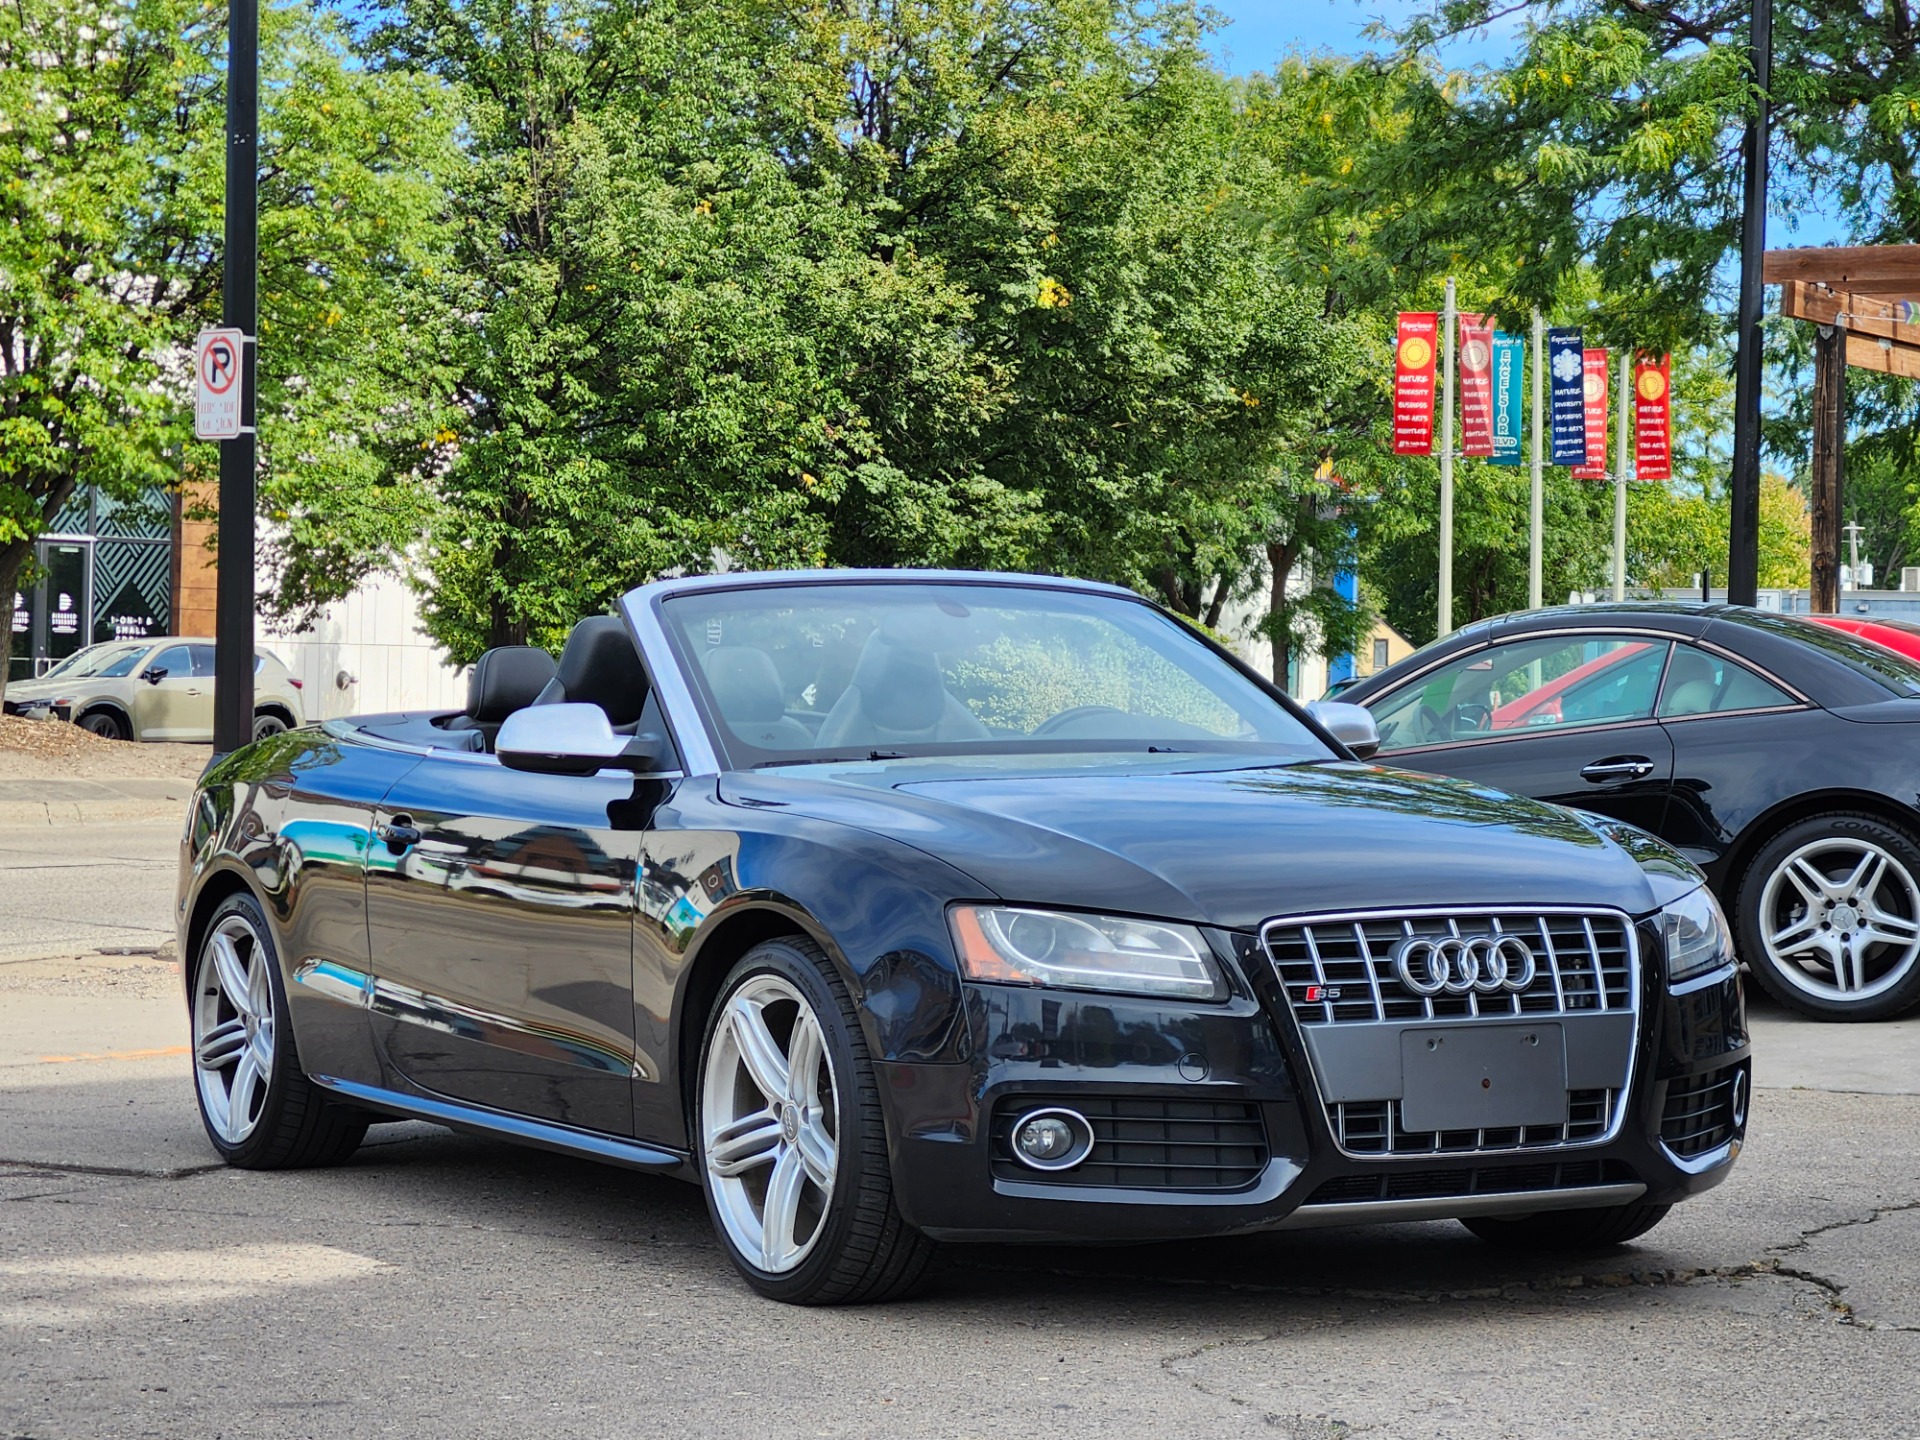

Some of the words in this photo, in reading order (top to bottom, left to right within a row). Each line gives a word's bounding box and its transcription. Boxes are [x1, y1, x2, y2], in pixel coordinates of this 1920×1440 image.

[1498, 350, 1511, 434] EXCELSIOR
[1554, 388, 1581, 396] NATURE
[111, 615, 142, 625] 1-ON-1
[116, 626, 147, 635] SMALL
[1830, 820, 1920, 865] CONTINE
[1314, 988, 1341, 999] S5
